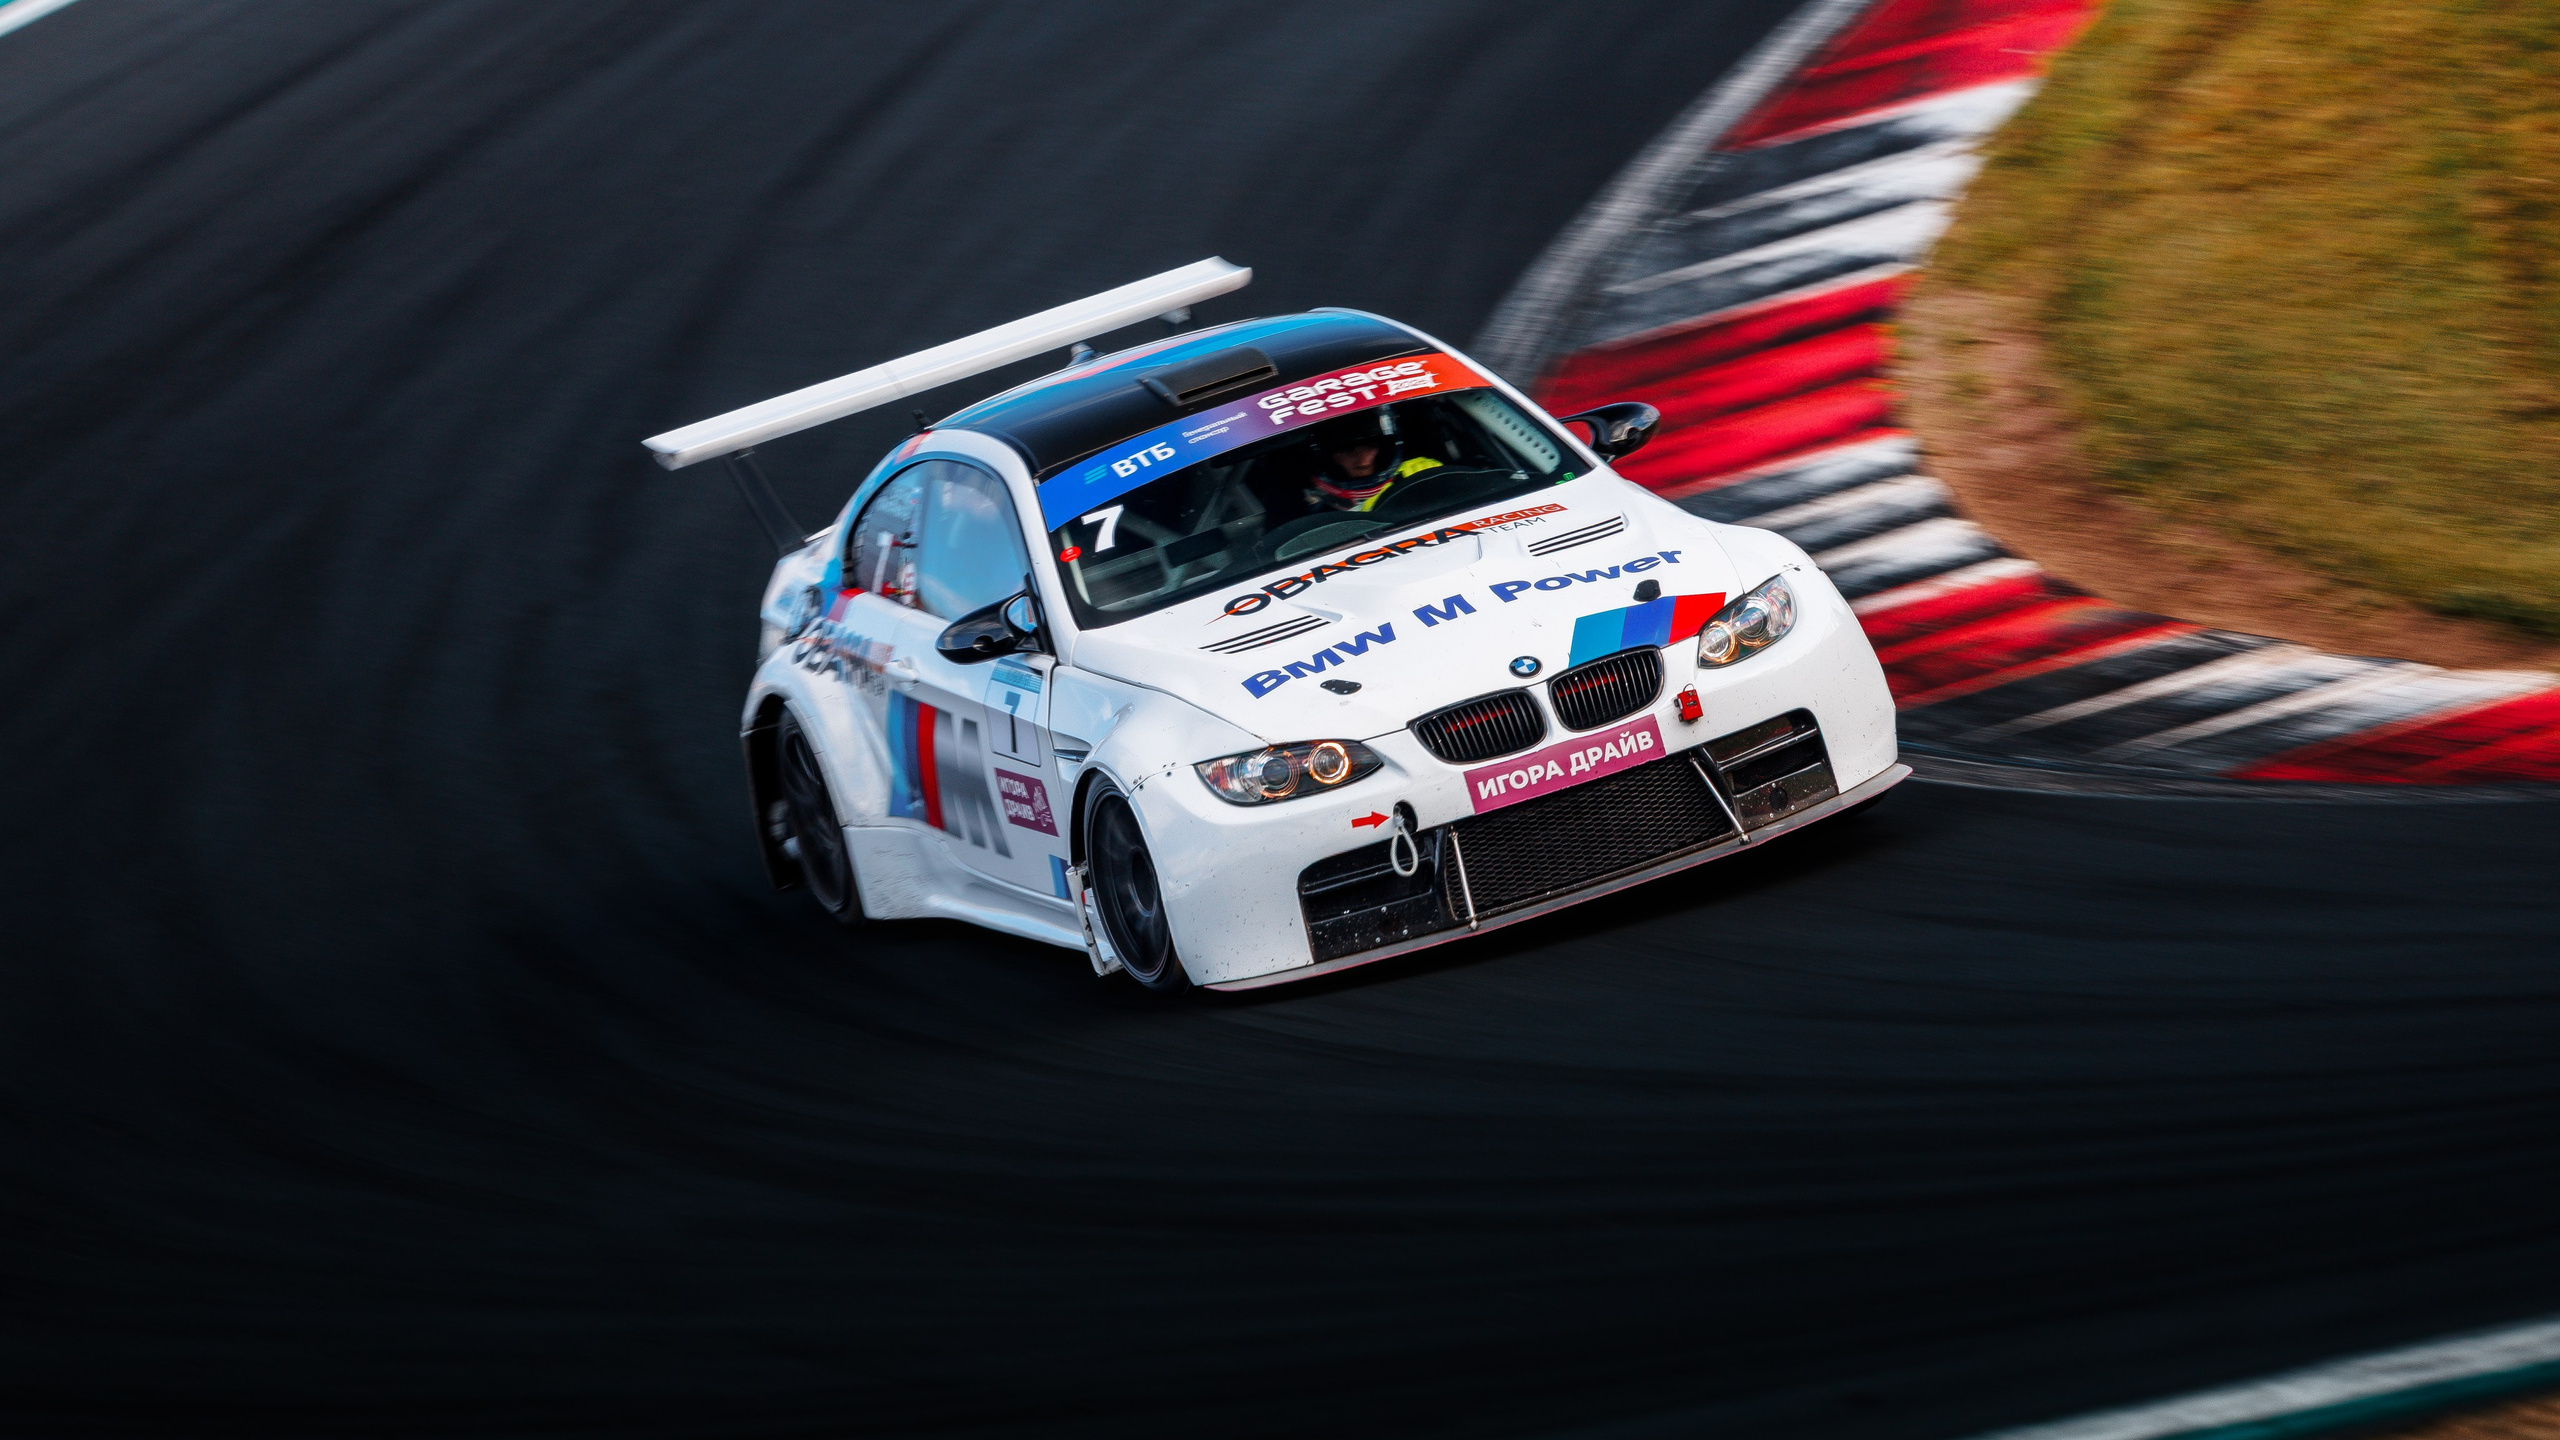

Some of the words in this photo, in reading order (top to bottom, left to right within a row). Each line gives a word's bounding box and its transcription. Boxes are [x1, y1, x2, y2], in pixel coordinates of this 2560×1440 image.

[1111, 441, 1176, 478] ВТБ
[1081, 504, 1124, 553] 7
[1471, 505, 1562, 528] RACING
[1483, 517, 1546, 534] TEAM
[1224, 527, 1485, 616] OBAGRA
[1242, 622, 1397, 699] BMW
[1413, 594, 1477, 628] M
[1489, 550, 1682, 603] Power
[1004, 690, 1021, 753] 7
[1477, 760, 1565, 801] ИГОРА
[1569, 731, 1655, 777] ДРАЙВ
